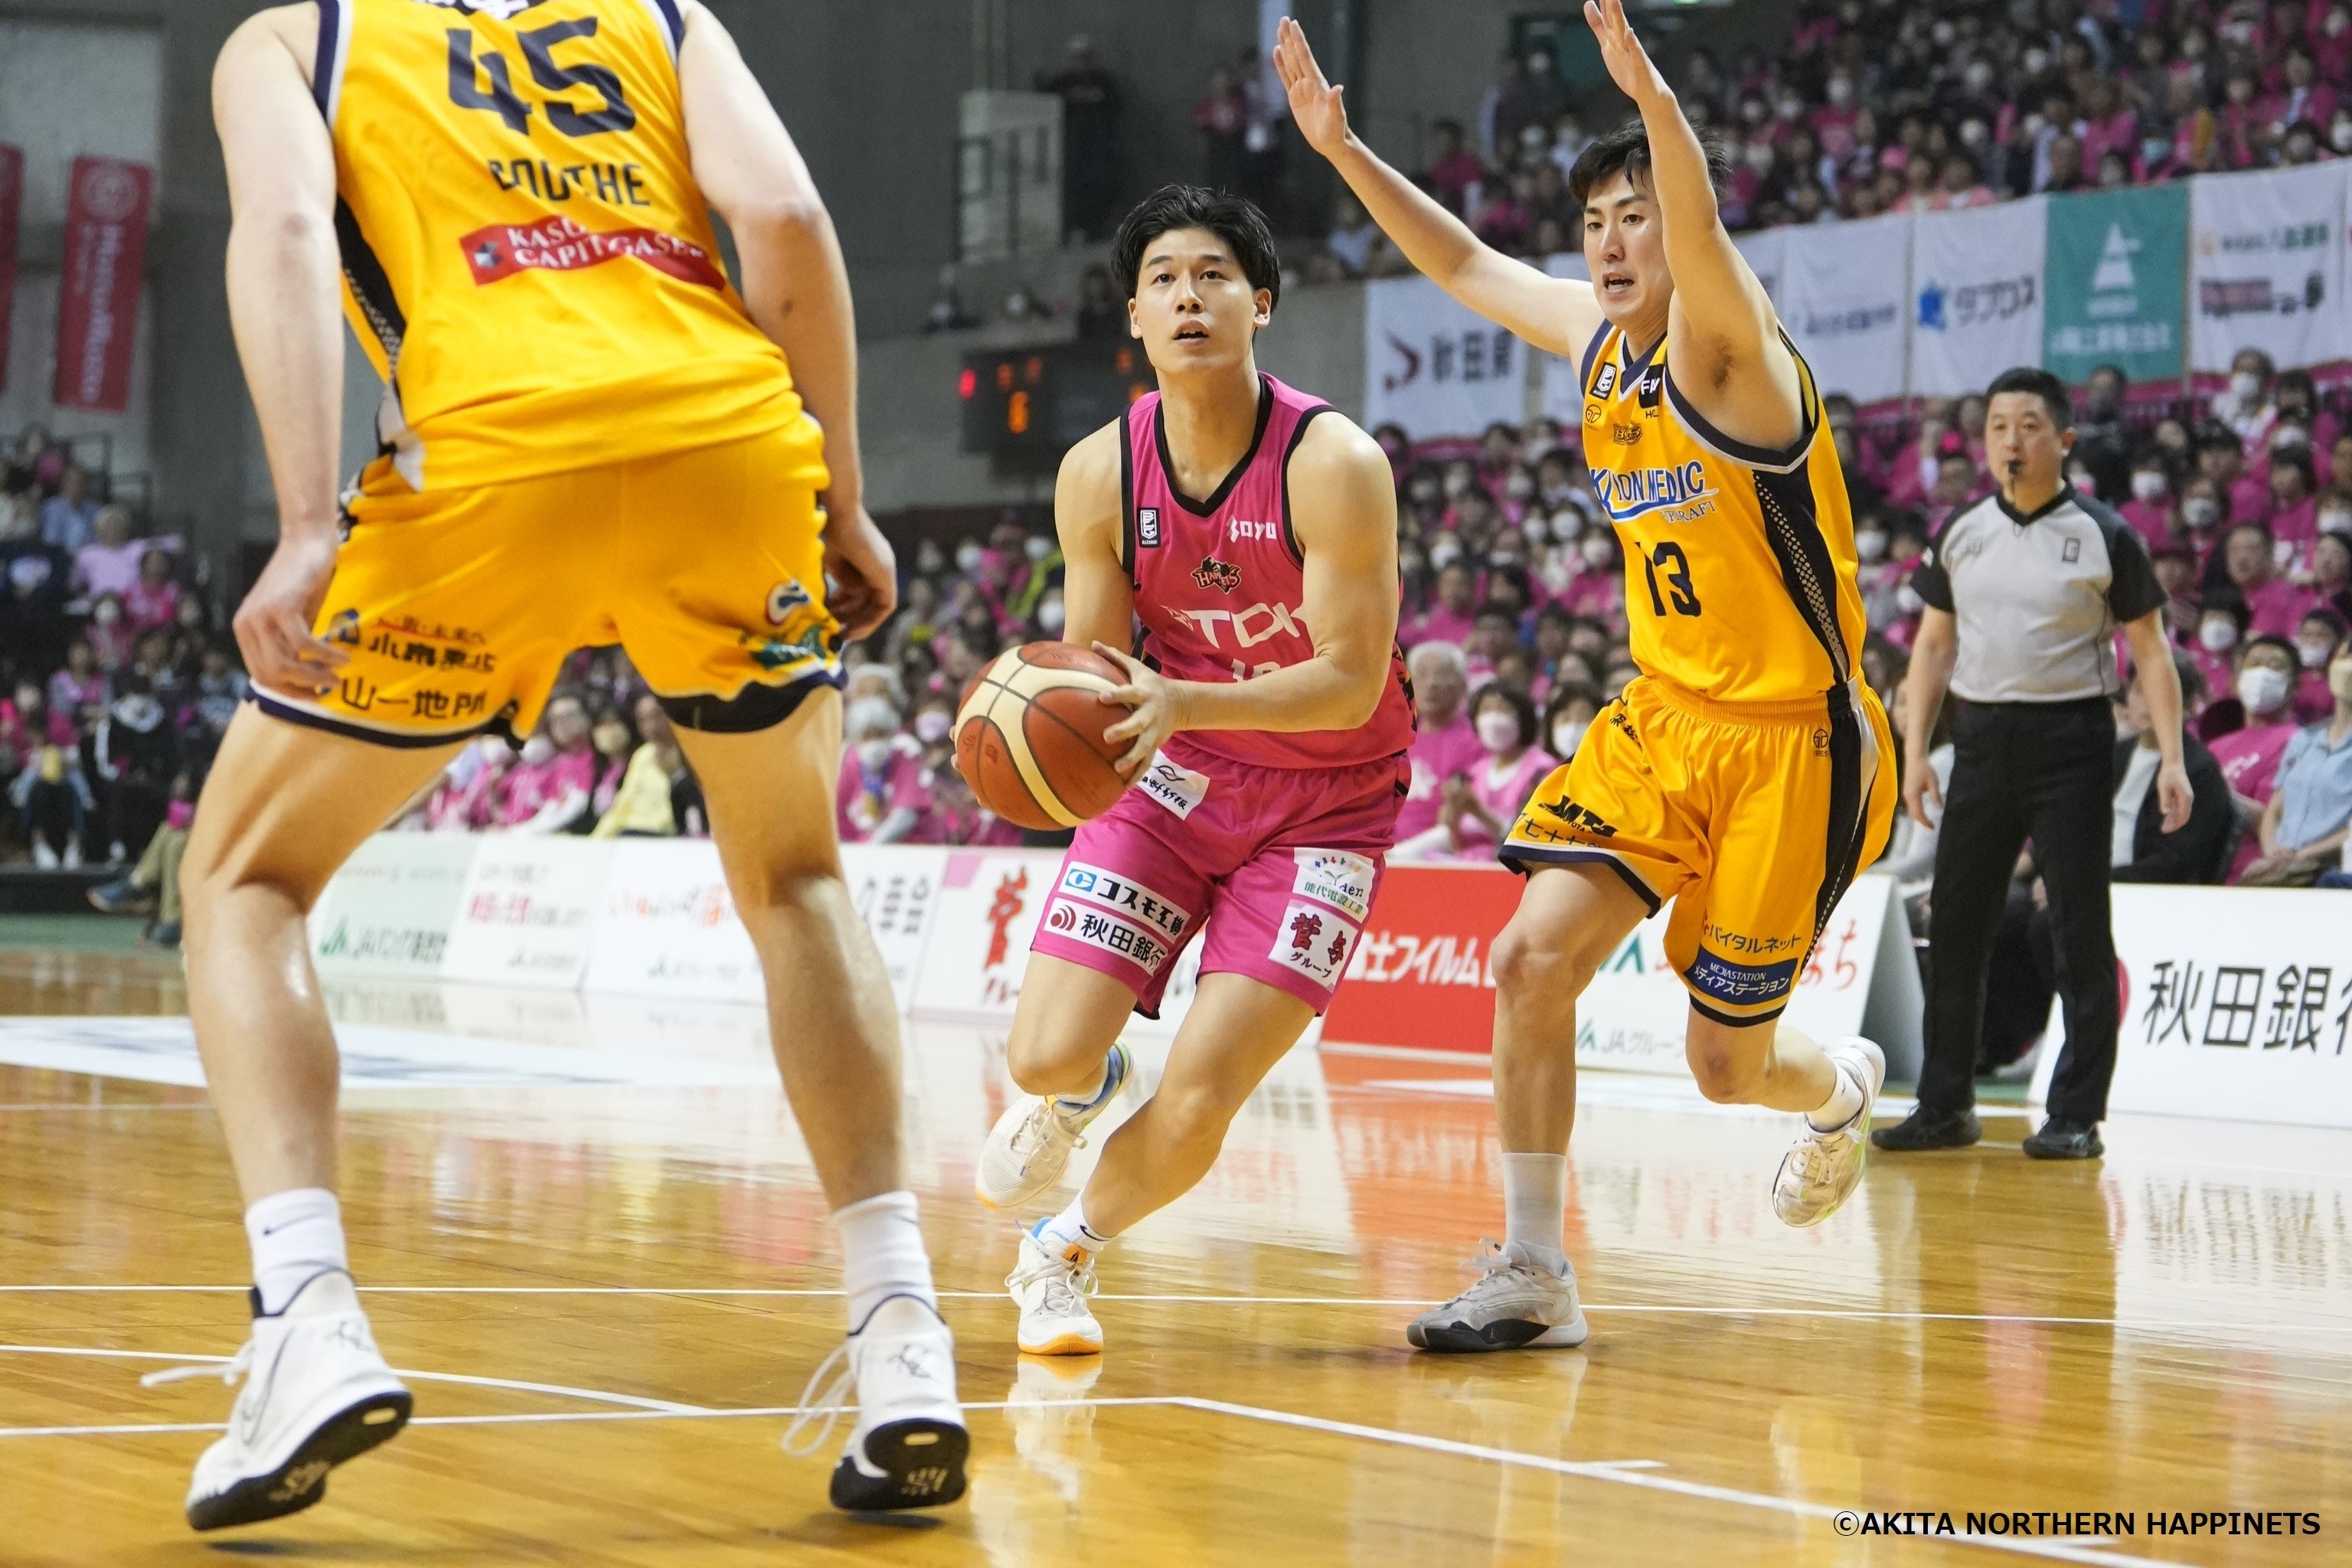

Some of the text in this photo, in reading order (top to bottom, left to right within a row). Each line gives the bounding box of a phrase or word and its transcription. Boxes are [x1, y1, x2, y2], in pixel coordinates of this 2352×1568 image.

[446, 16, 636, 138] 45
[1635, 541, 1701, 616] 13
[341, 677, 488, 720] 山一地所
[1097, 878, 1184, 936] コスモ工機
[1080, 913, 1165, 970] 秋田銀行
[1709, 924, 1801, 954] バイタルネット
[1290, 951, 1332, 978] グループ
[1694, 965, 1789, 995] メディアステーション
[1710, 962, 1766, 982] MEDIASTATION
